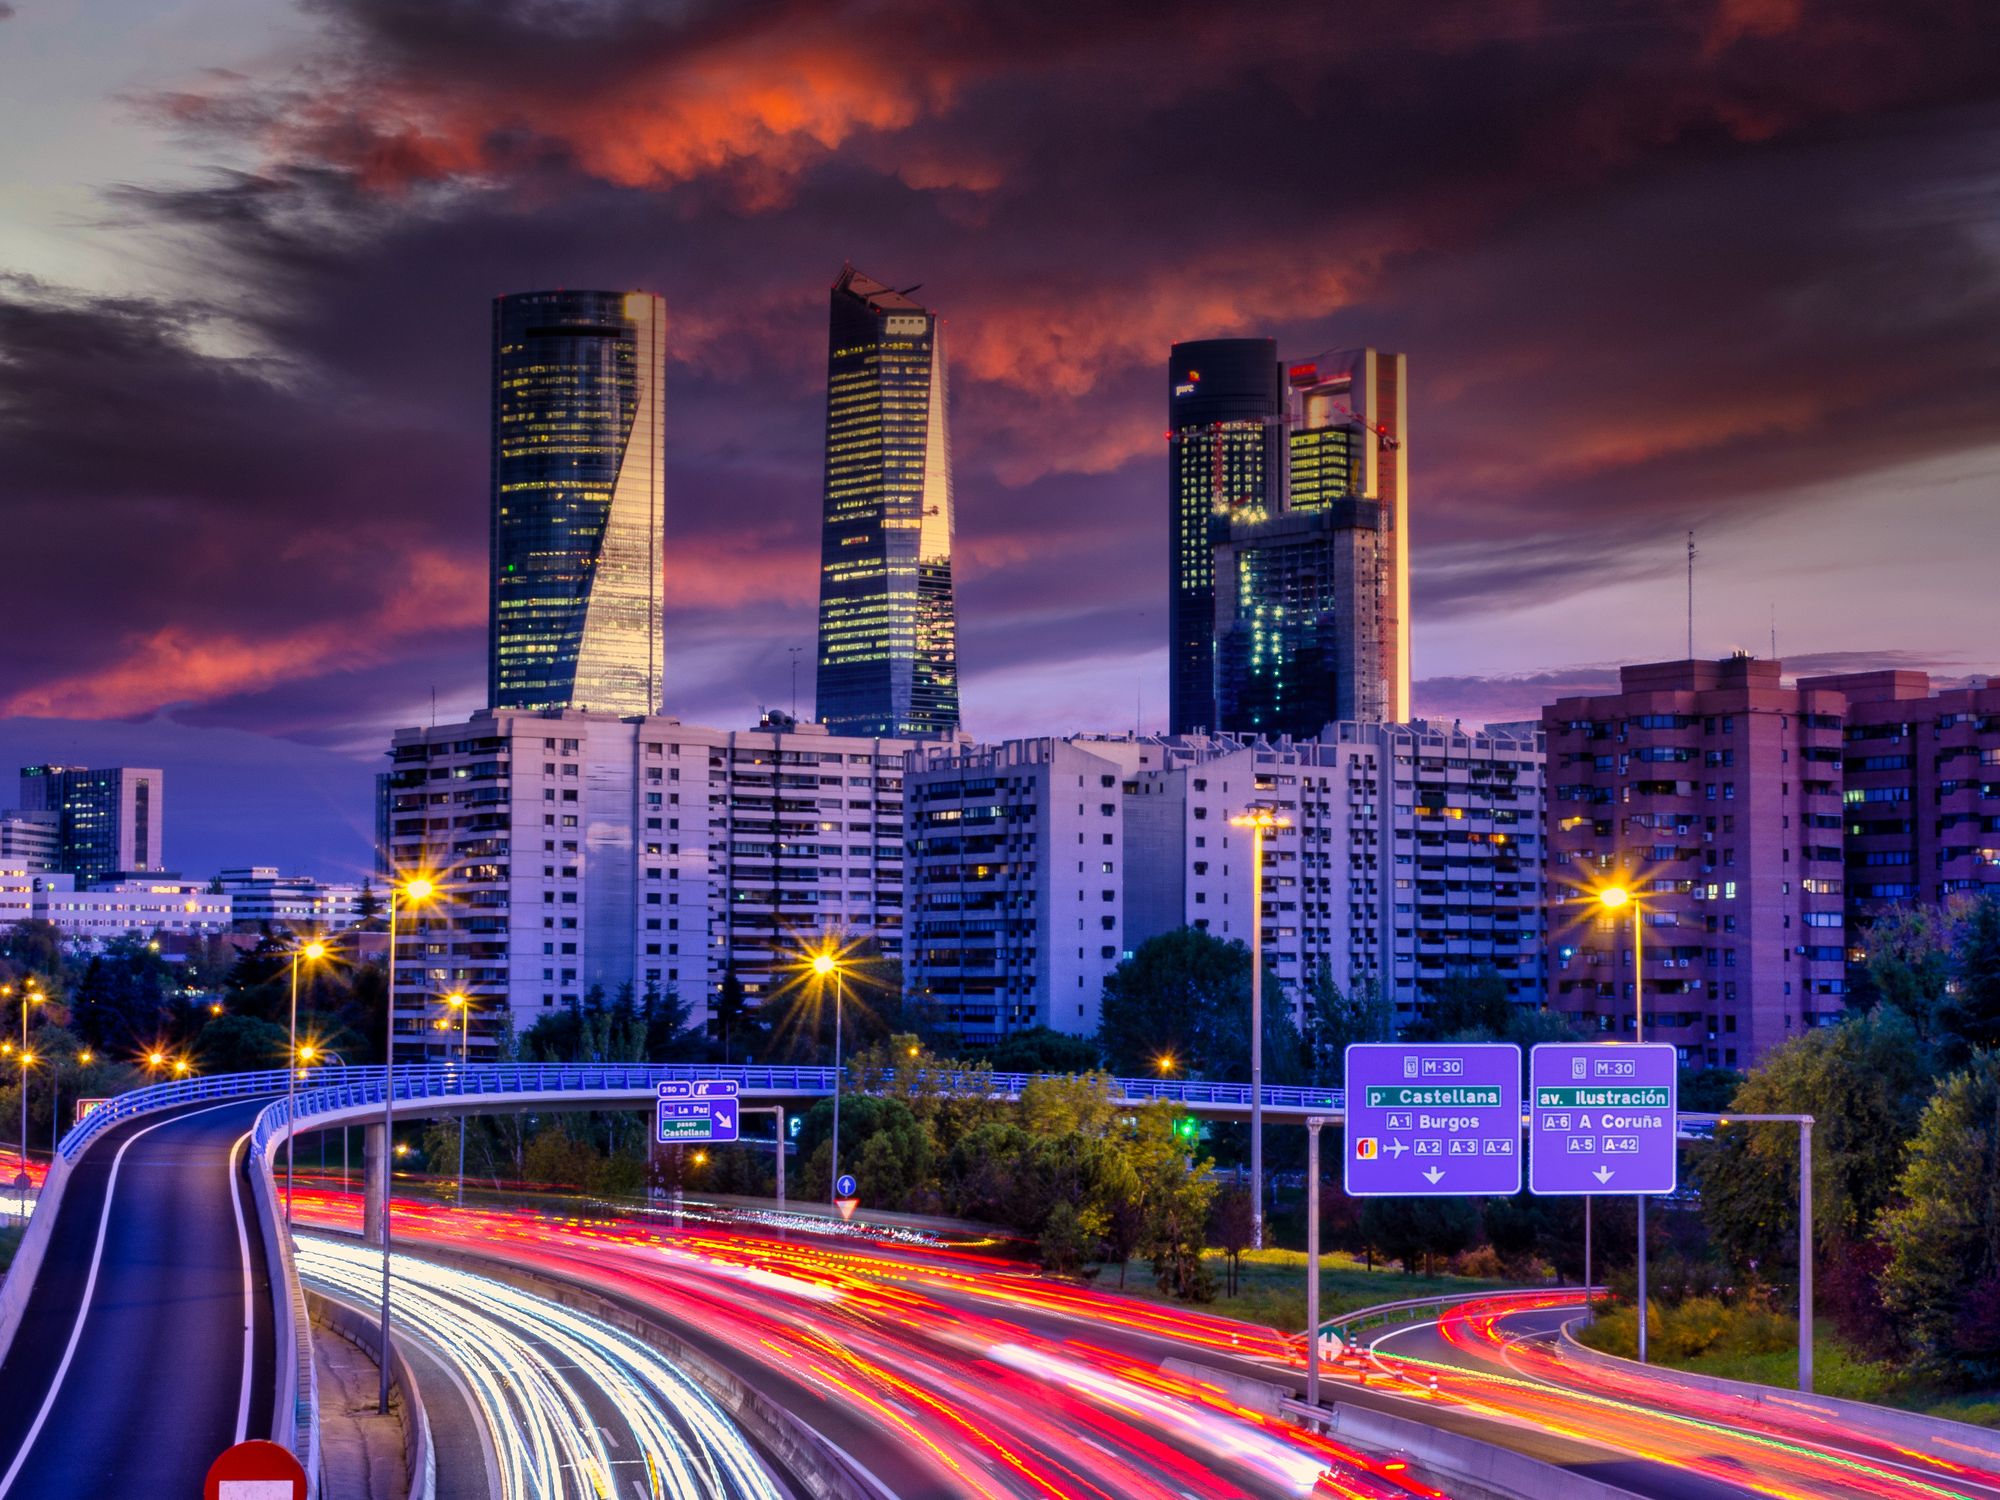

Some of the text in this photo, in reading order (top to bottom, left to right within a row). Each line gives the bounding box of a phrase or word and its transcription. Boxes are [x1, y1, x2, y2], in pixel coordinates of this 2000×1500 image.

[1425, 1061, 1461, 1073] M-30
[1596, 1063, 1633, 1074] M-30
[1399, 1089, 1498, 1105] Castellana
[1540, 1089, 1666, 1105] av. Ilustración
[678, 1105, 708, 1114] La Paz
[677, 1121, 697, 1129] paseo
[1389, 1114, 1480, 1131] A-1 Burgos
[1545, 1113, 1663, 1129] A-6 A Coruña
[663, 1129, 710, 1137] Castellana
[1416, 1141, 1511, 1153] A-2 A-3 A-4
[1569, 1139, 1637, 1151] A-5 A-42
